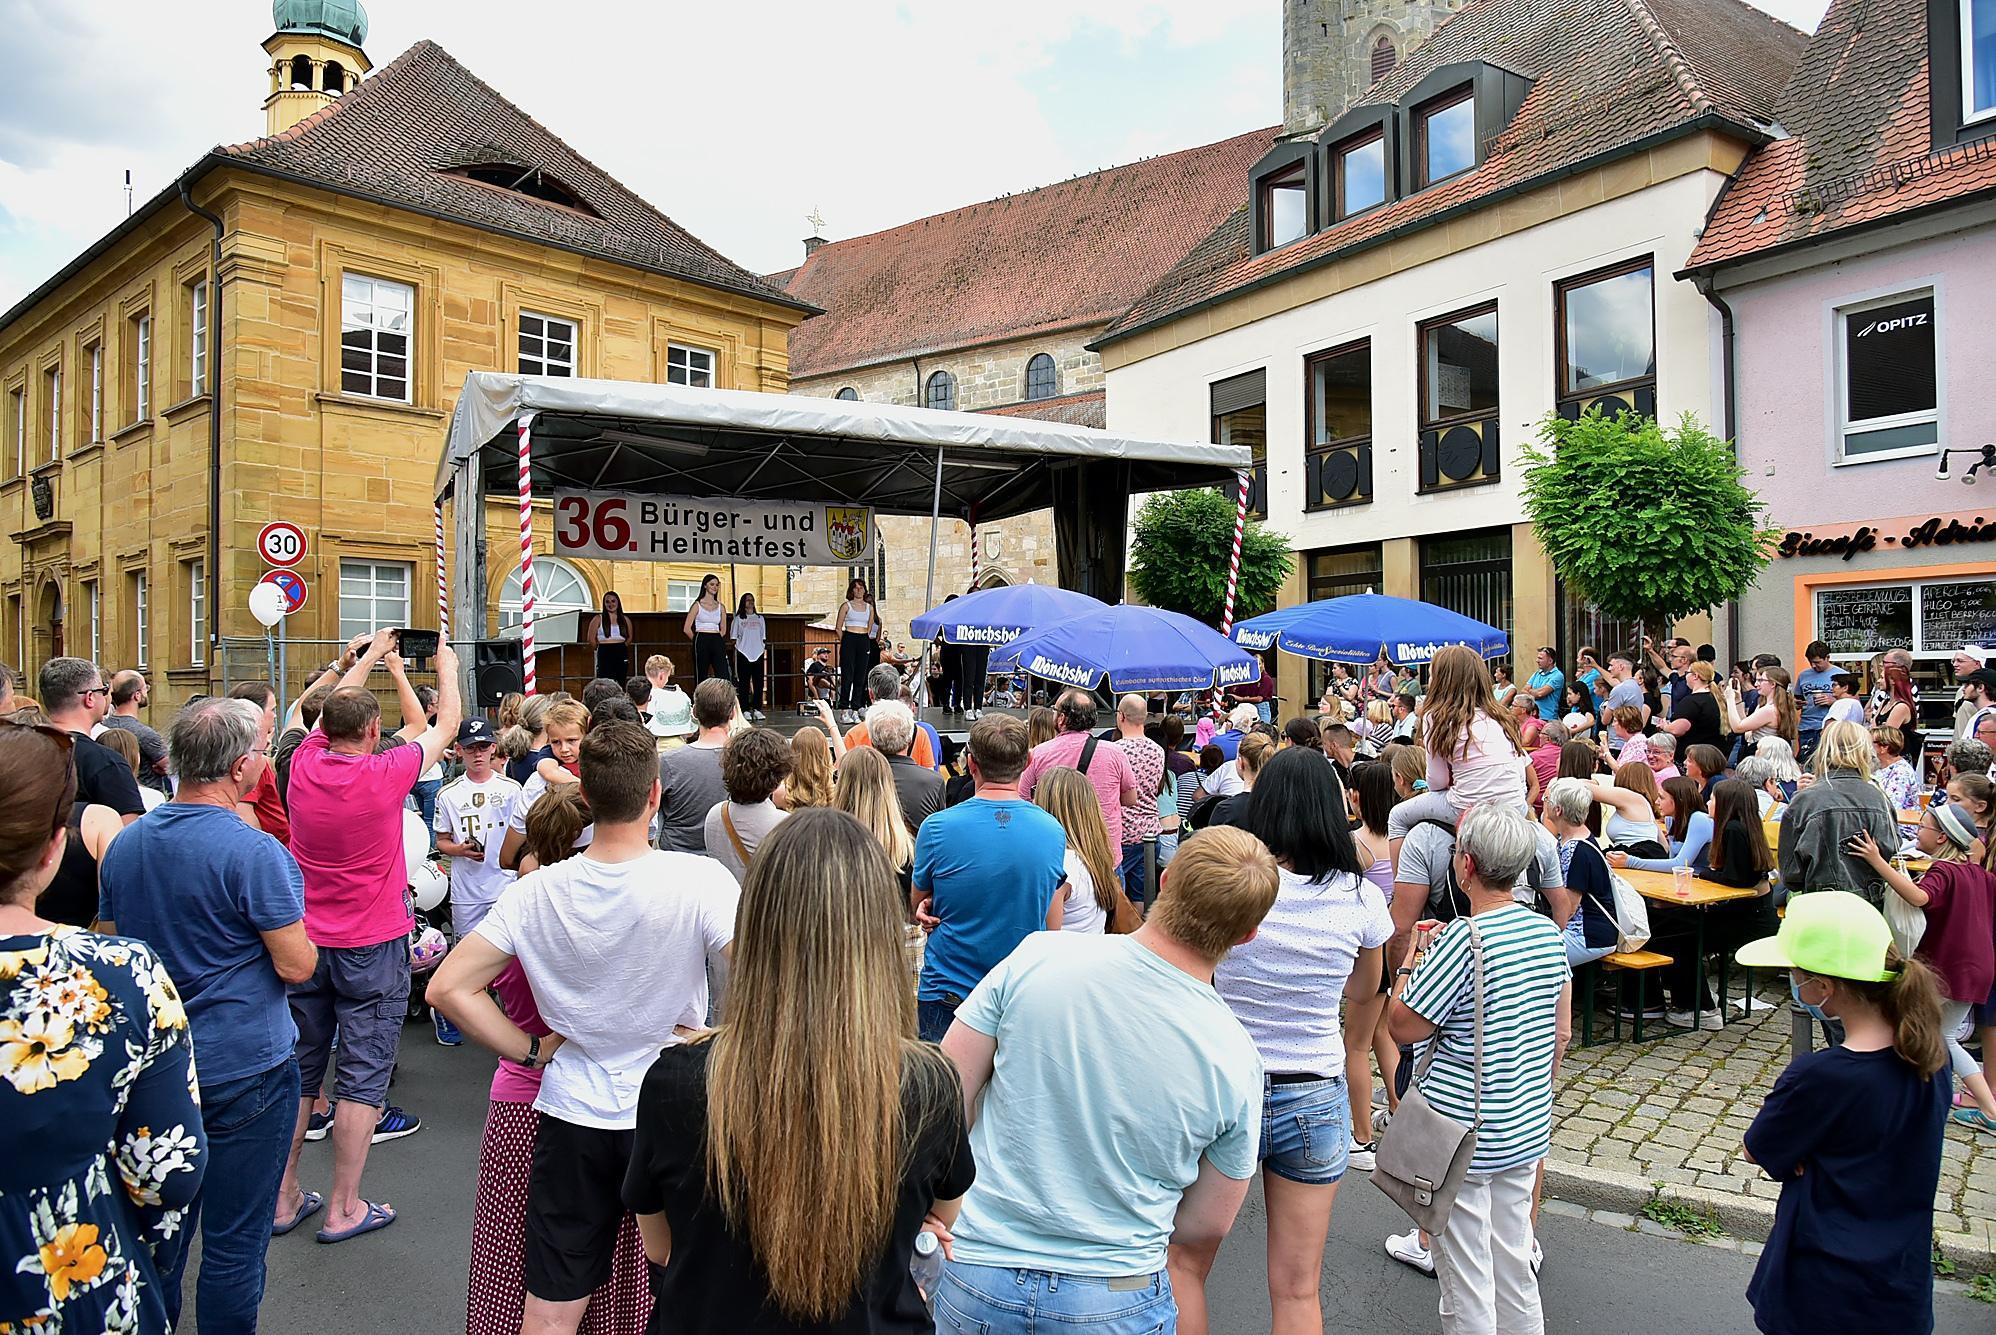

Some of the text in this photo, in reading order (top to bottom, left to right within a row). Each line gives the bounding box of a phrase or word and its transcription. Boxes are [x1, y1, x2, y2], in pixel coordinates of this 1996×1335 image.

[1877, 313, 1927, 333] OPITZ
[557, 496, 815, 552] 36. Bürger- und
[269, 534, 297, 554] 30
[650, 530, 807, 558] Heimatfest
[1924, 600, 1952, 610] HUGO
[956, 624, 1021, 643] Mönchshof
[1821, 628, 1853, 640] OTWEIN
[1397, 641, 1465, 661] Mönch
[1030, 654, 1094, 686] Mönchshof
